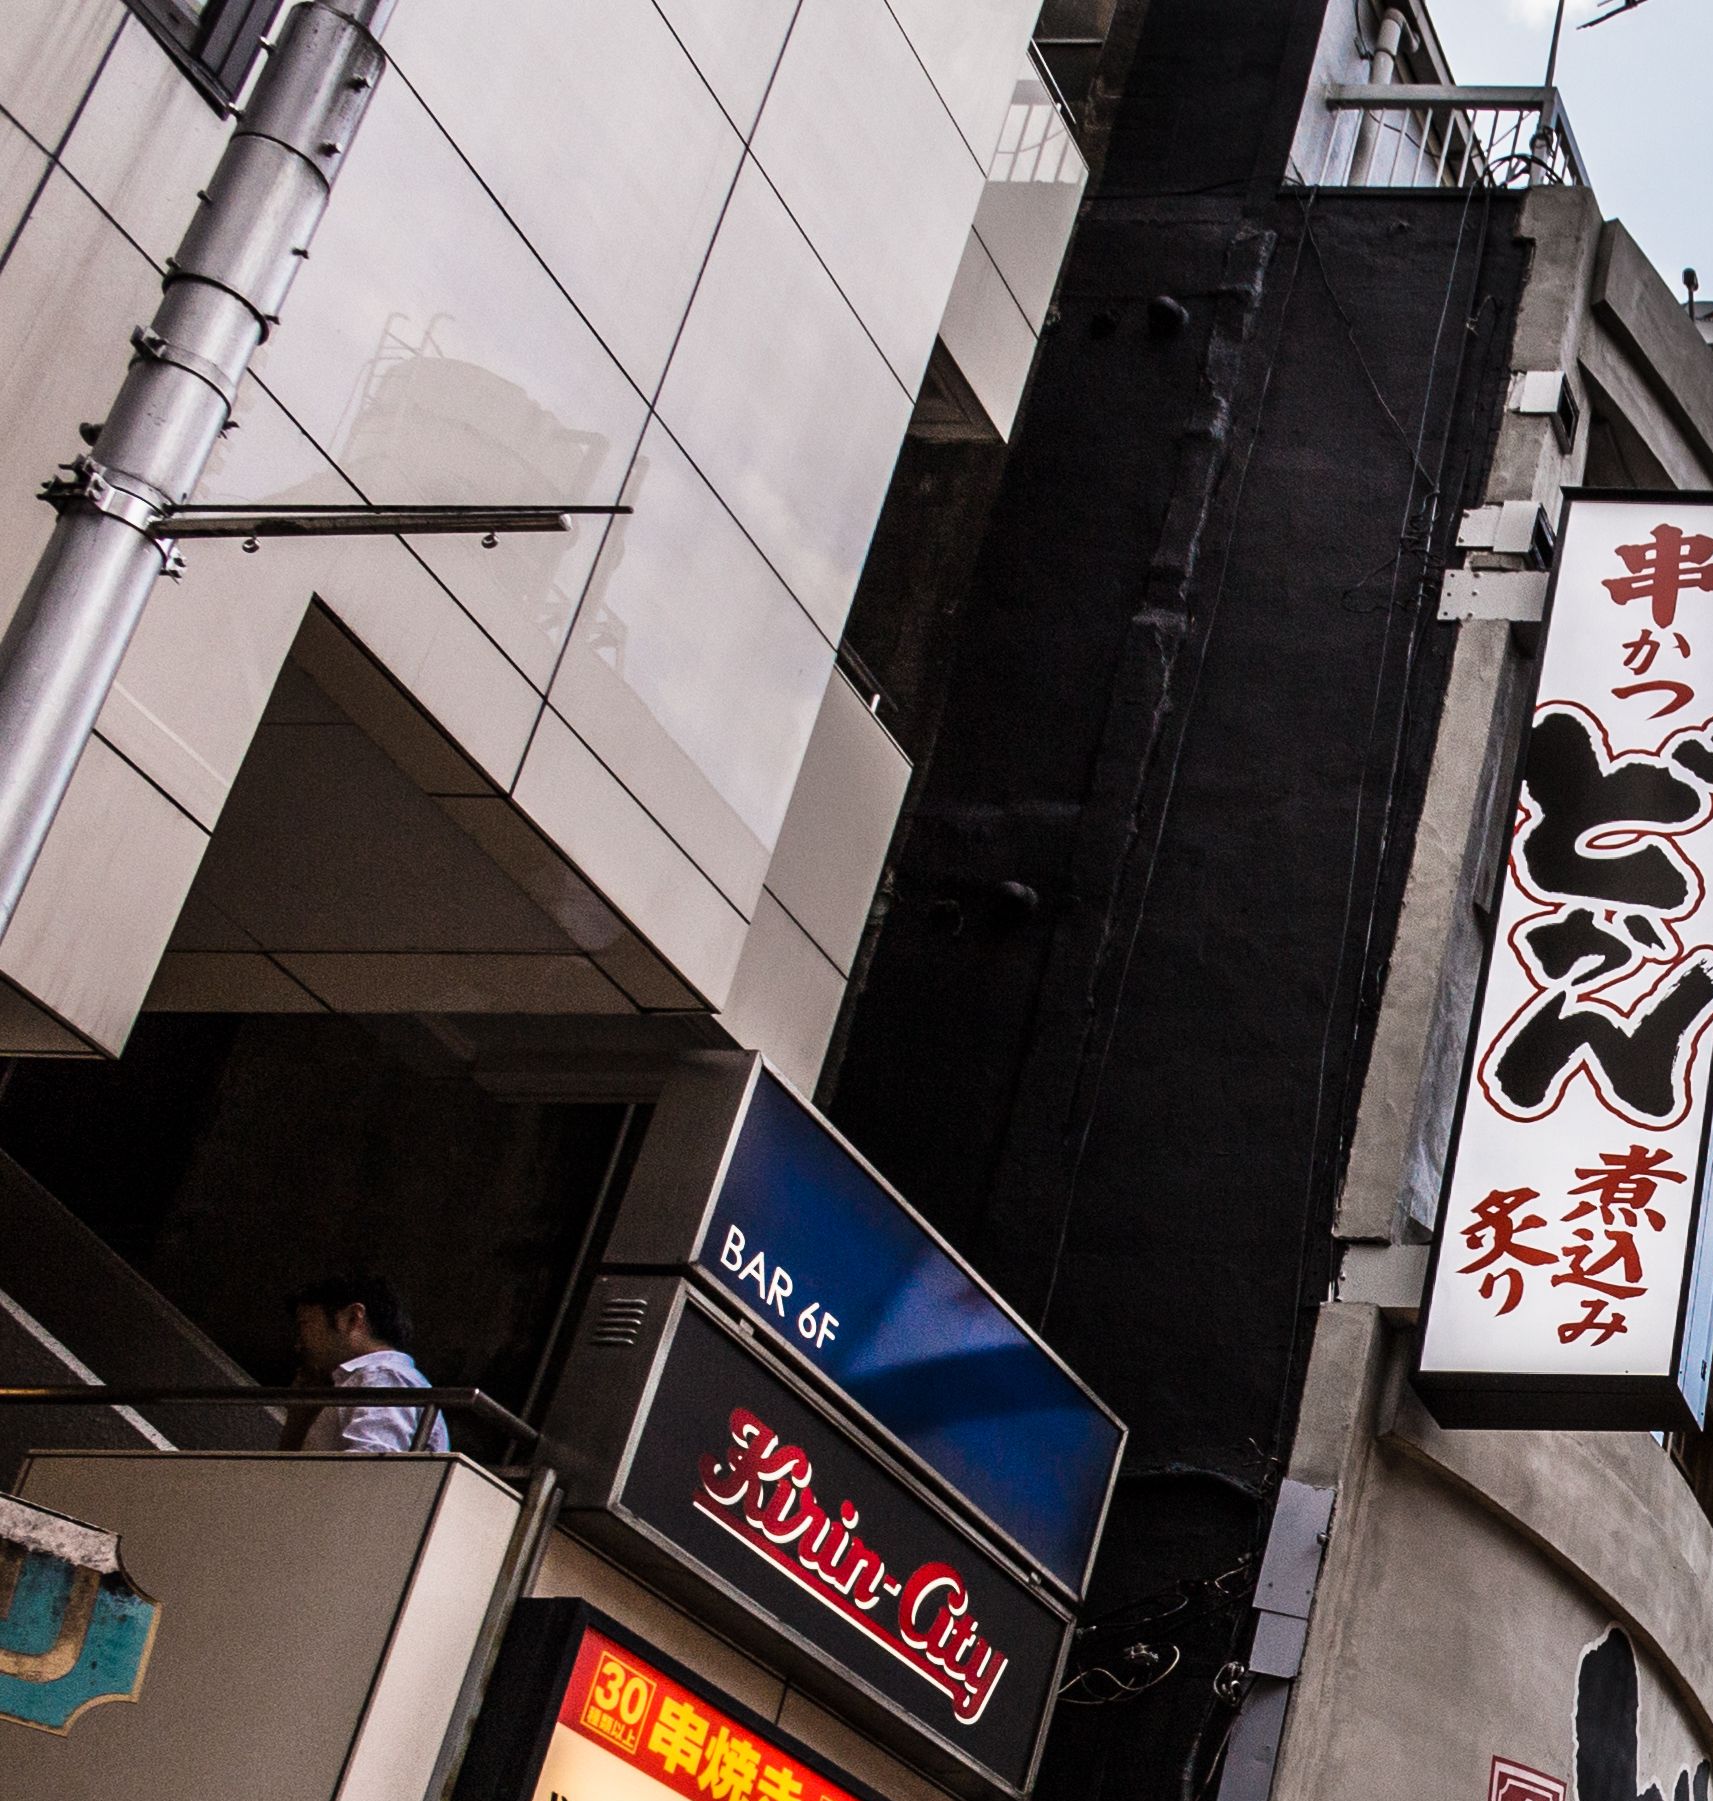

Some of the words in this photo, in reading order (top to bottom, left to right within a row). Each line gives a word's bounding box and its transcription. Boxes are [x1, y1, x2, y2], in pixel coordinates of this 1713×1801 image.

[719, 1224, 795, 1316] BAR
[797, 1299, 844, 1351] 6F
[1456, 1187, 1560, 1319] 炙り
[1550, 1143, 1688, 1348] 煮込み
[694, 1406, 1010, 1726] Kirin-City
[593, 1662, 645, 1727] 30
